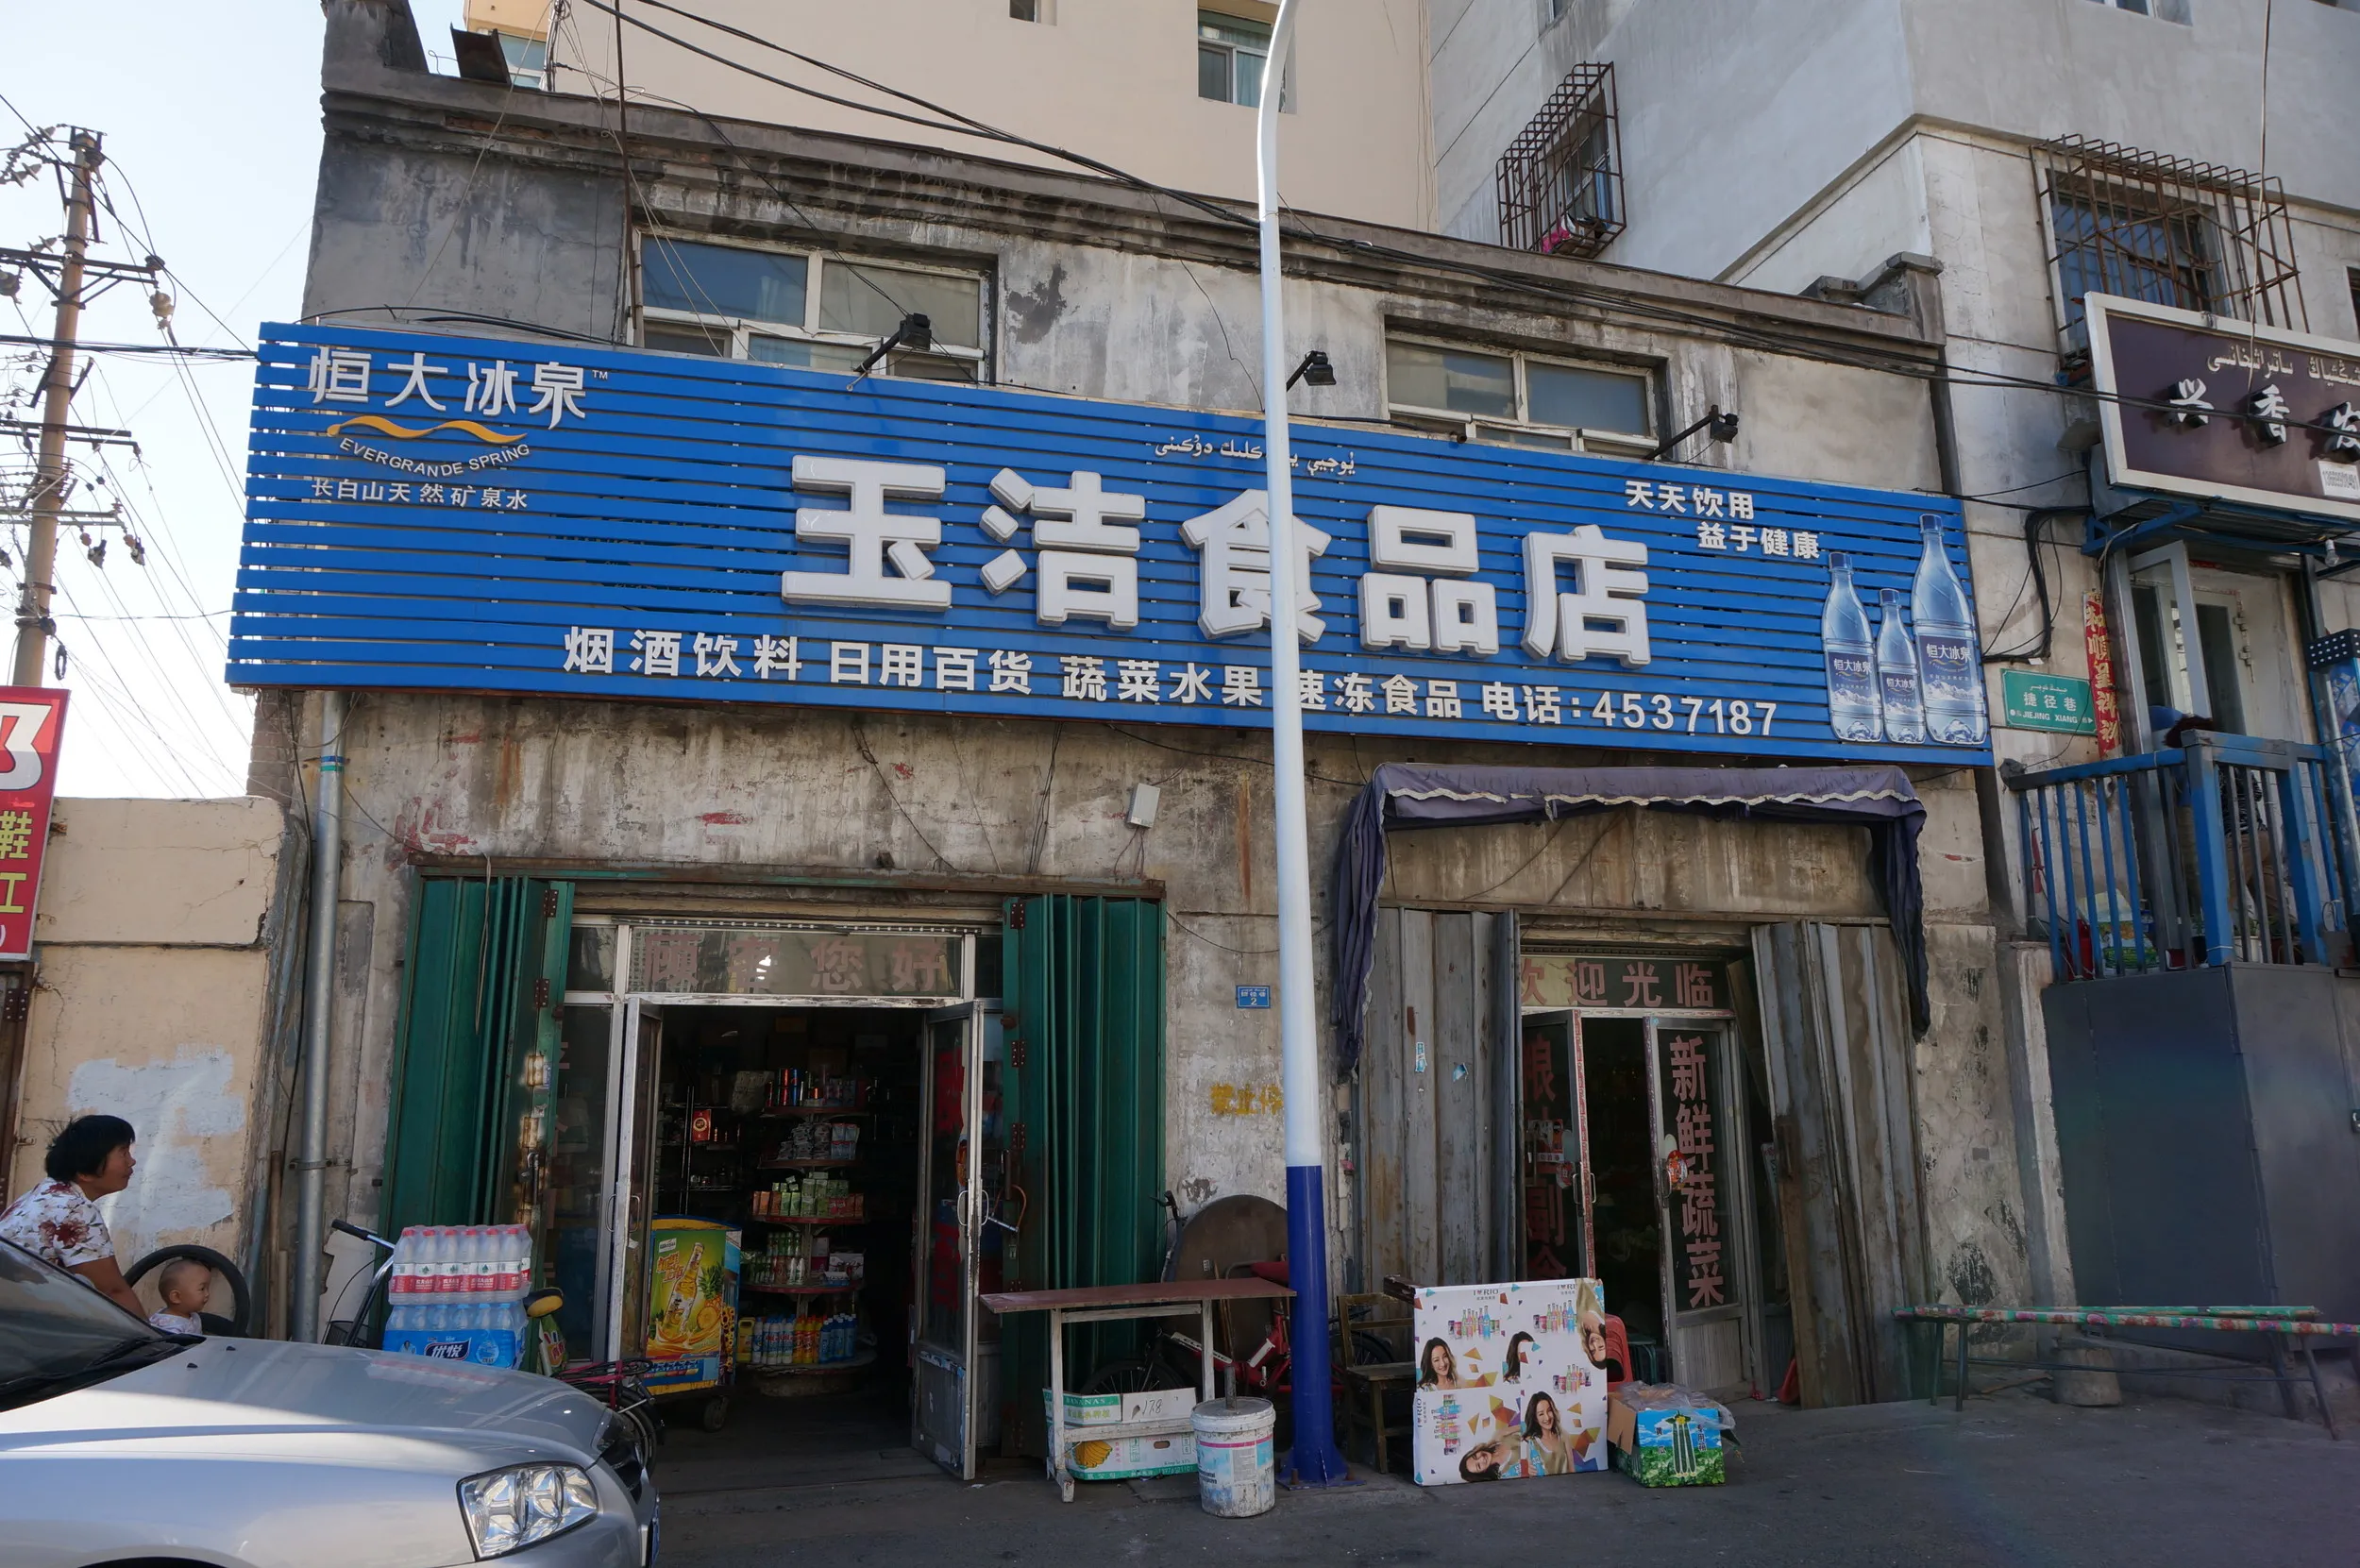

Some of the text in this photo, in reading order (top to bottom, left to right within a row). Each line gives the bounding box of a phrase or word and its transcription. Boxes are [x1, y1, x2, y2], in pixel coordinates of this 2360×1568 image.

[309, 346, 585, 430] 恒大冰泉
[339, 437, 531, 478] EVERGRANDE SPRING
[312, 478, 528, 509] 长白山天然矿泉水
[1625, 480, 1754, 520] 天天饮用
[1696, 521, 1820, 559] 益于健康
[781, 454, 1650, 669] 玉洁食品店
[563, 626, 802, 681] 烟酒饮料
[829, 640, 1034, 696] 日用百货
[1058, 655, 1263, 707] 蔬菜水果
[1299, 669, 1461, 718] 速冻食品
[2023, 691, 2076, 712] 捷径巷
[2023, 711, 2050, 720] JIEJING
[2054, 714, 2078, 723] XIANG
[1669, 1036, 1725, 1309] 新鲜蔬菜
[1066, 1397, 1105, 1406] BANANAS
